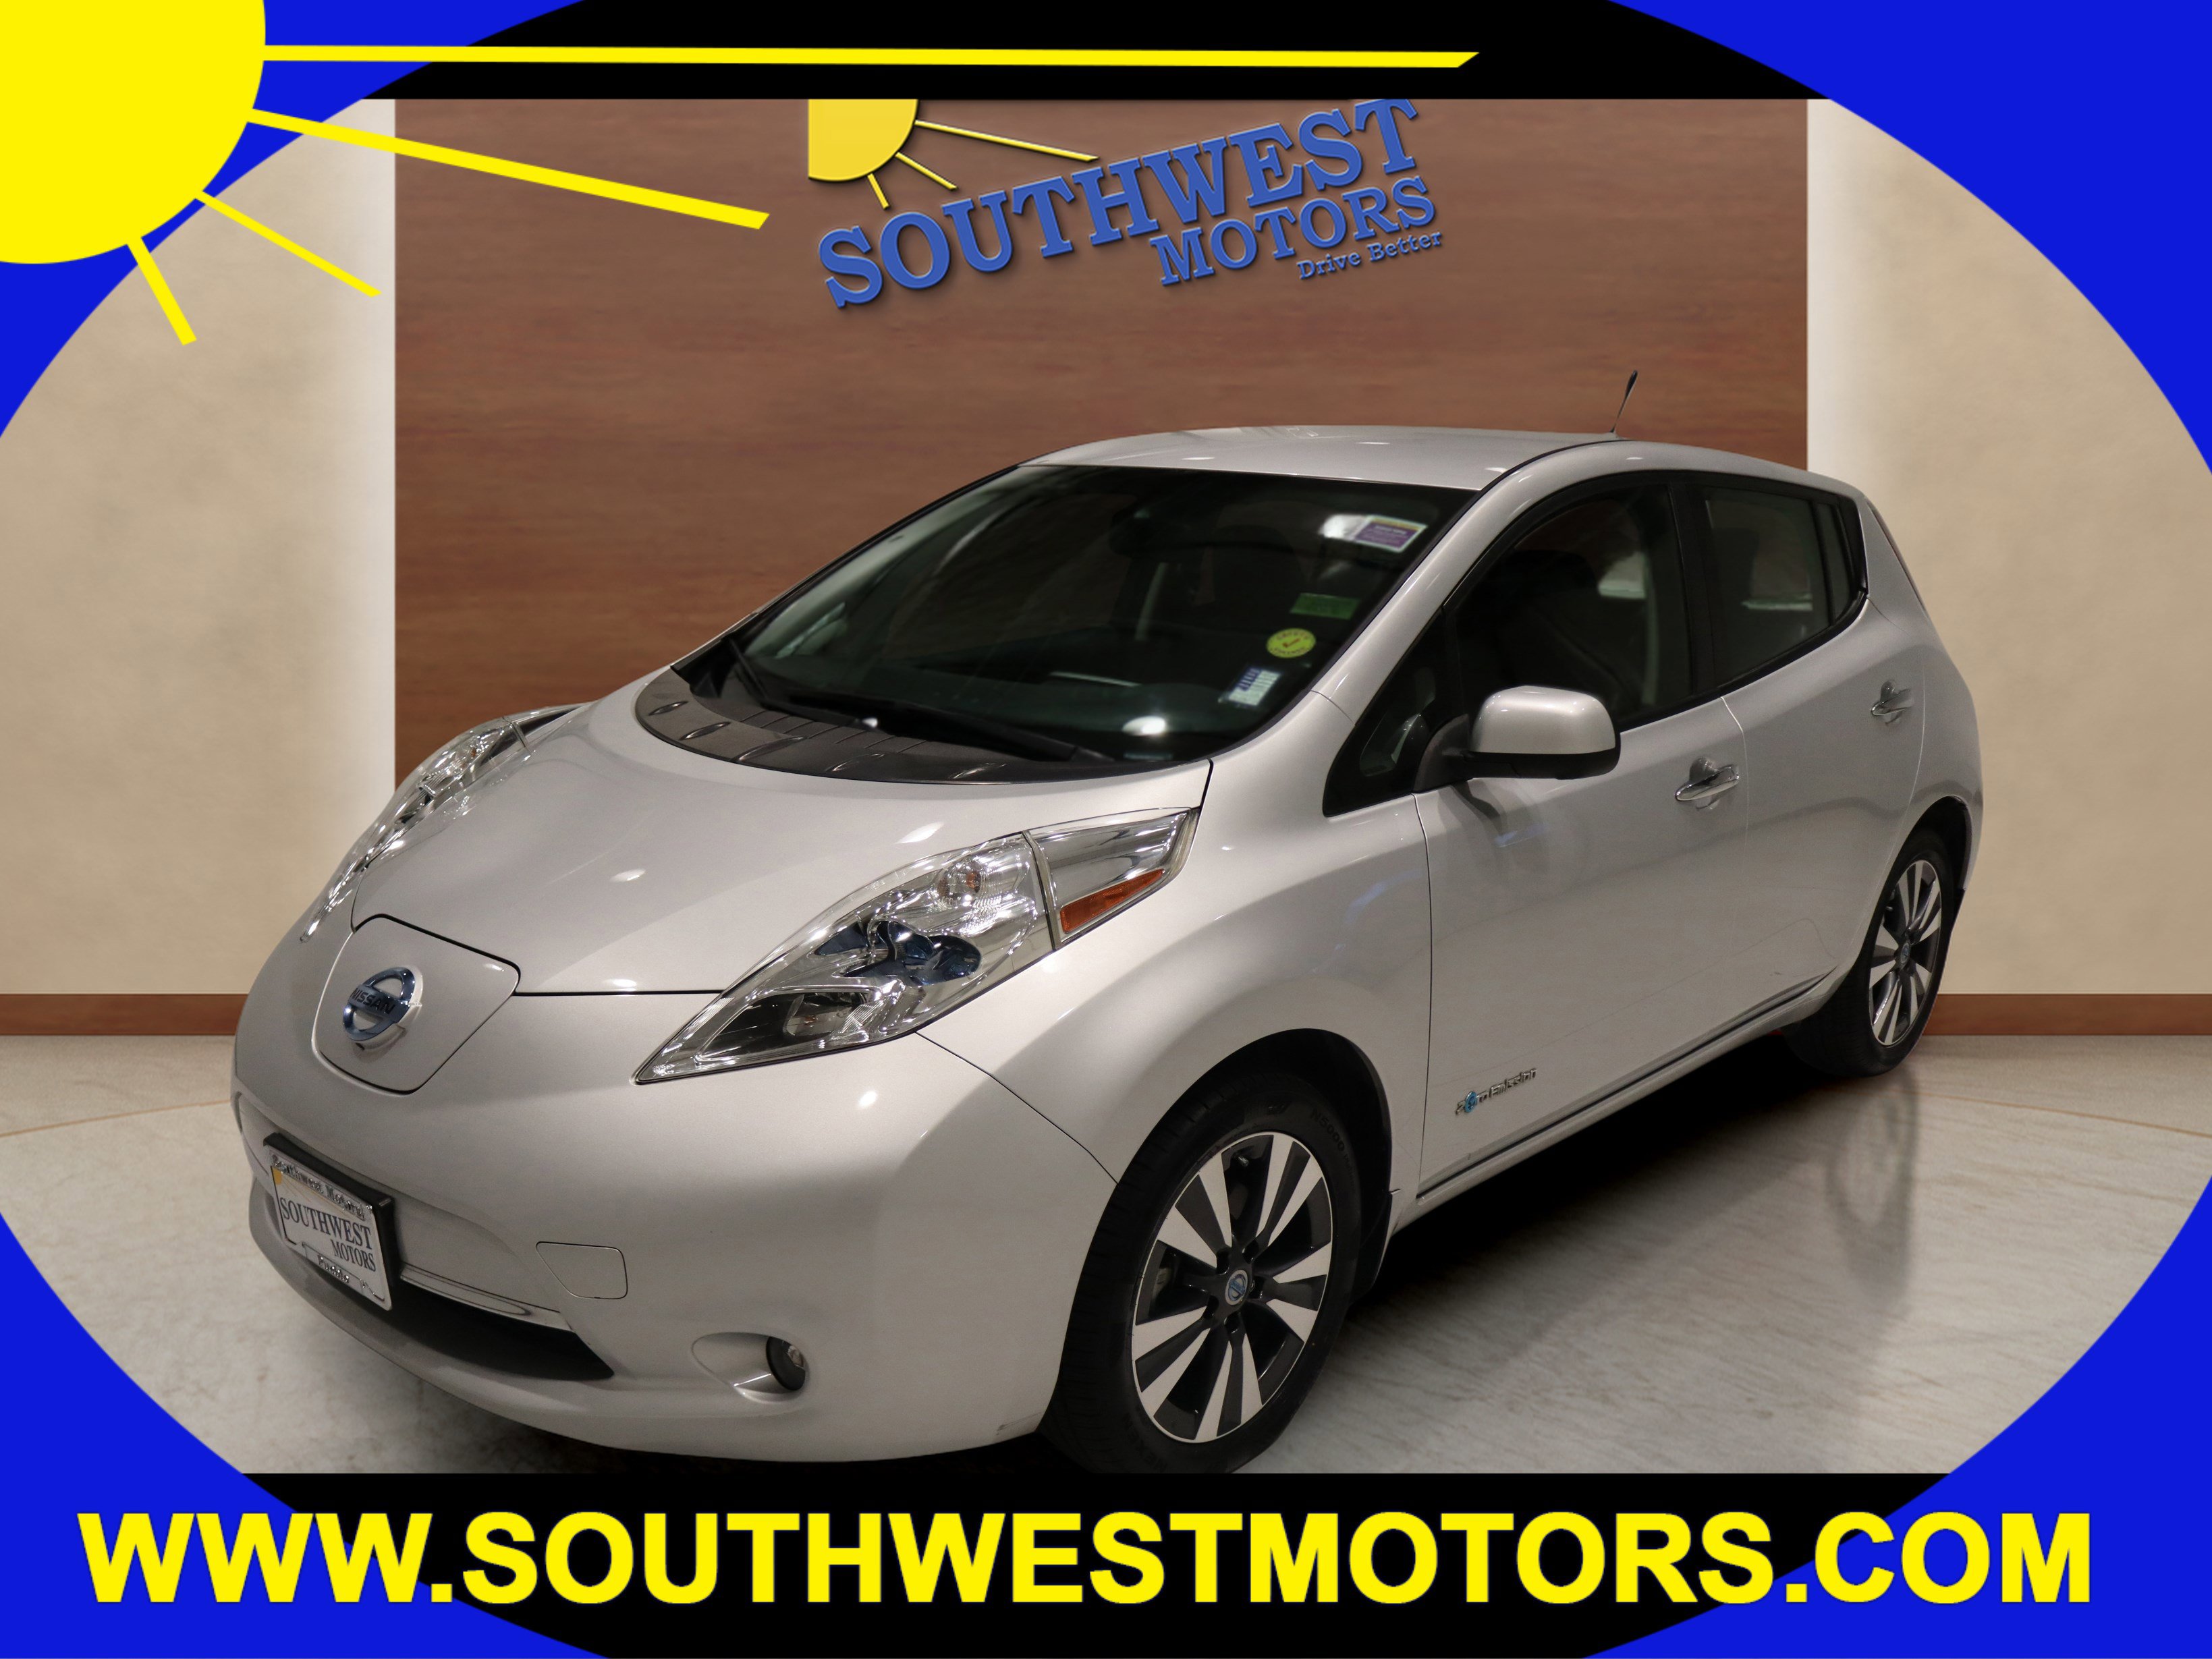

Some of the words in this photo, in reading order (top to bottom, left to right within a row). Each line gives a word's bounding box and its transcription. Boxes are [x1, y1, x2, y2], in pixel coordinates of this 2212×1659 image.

[819, 99, 1417, 308] SOUTHWEST
[1150, 177, 1435, 285] MOTORS
[1297, 243, 1360, 279] Drive
[1367, 233, 1442, 261] Better
[350, 988, 395, 1014] NISSAN
[279, 1198, 372, 1249] SOUTHWEST
[330, 1239, 376, 1272] MOTORS
